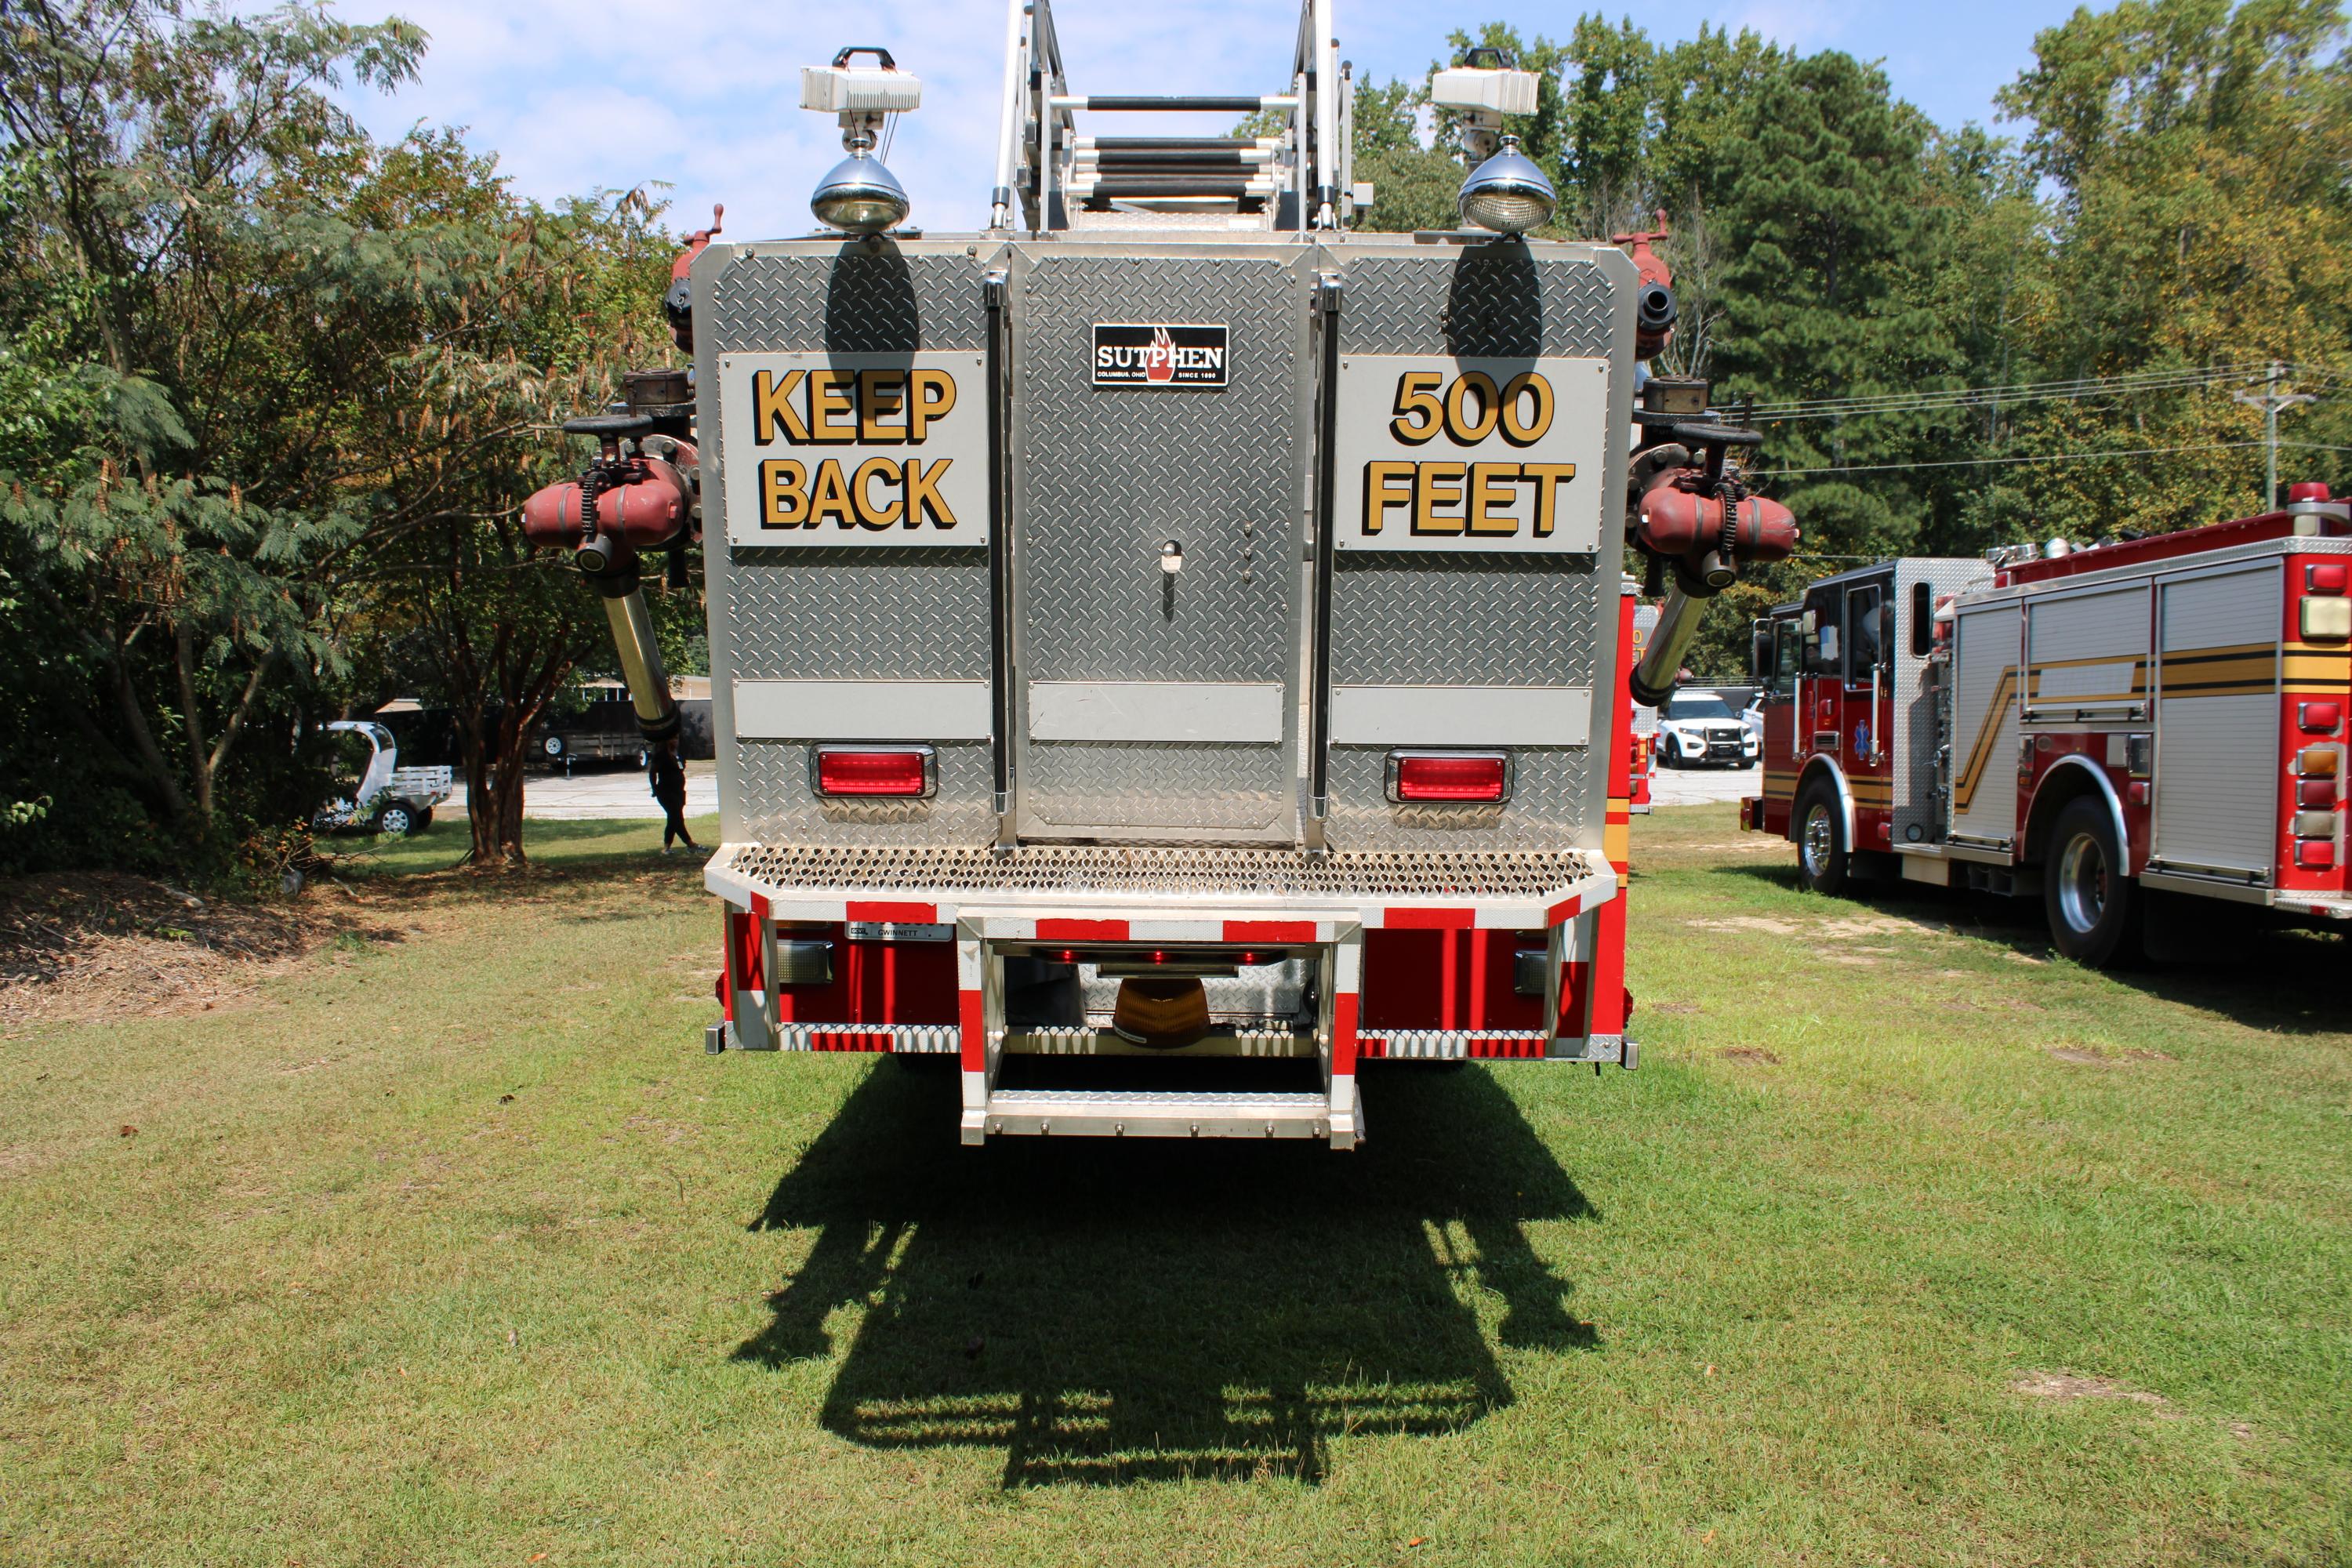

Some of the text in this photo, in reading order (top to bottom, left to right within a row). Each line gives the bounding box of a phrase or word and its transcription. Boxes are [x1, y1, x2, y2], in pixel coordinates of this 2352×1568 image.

[1098, 346, 1223, 368] SUTPHEN
[752, 368, 957, 446] KEEP
[1389, 371, 1555, 447] 500
[757, 456, 957, 531] BACK
[1362, 461, 1576, 538] FEET
